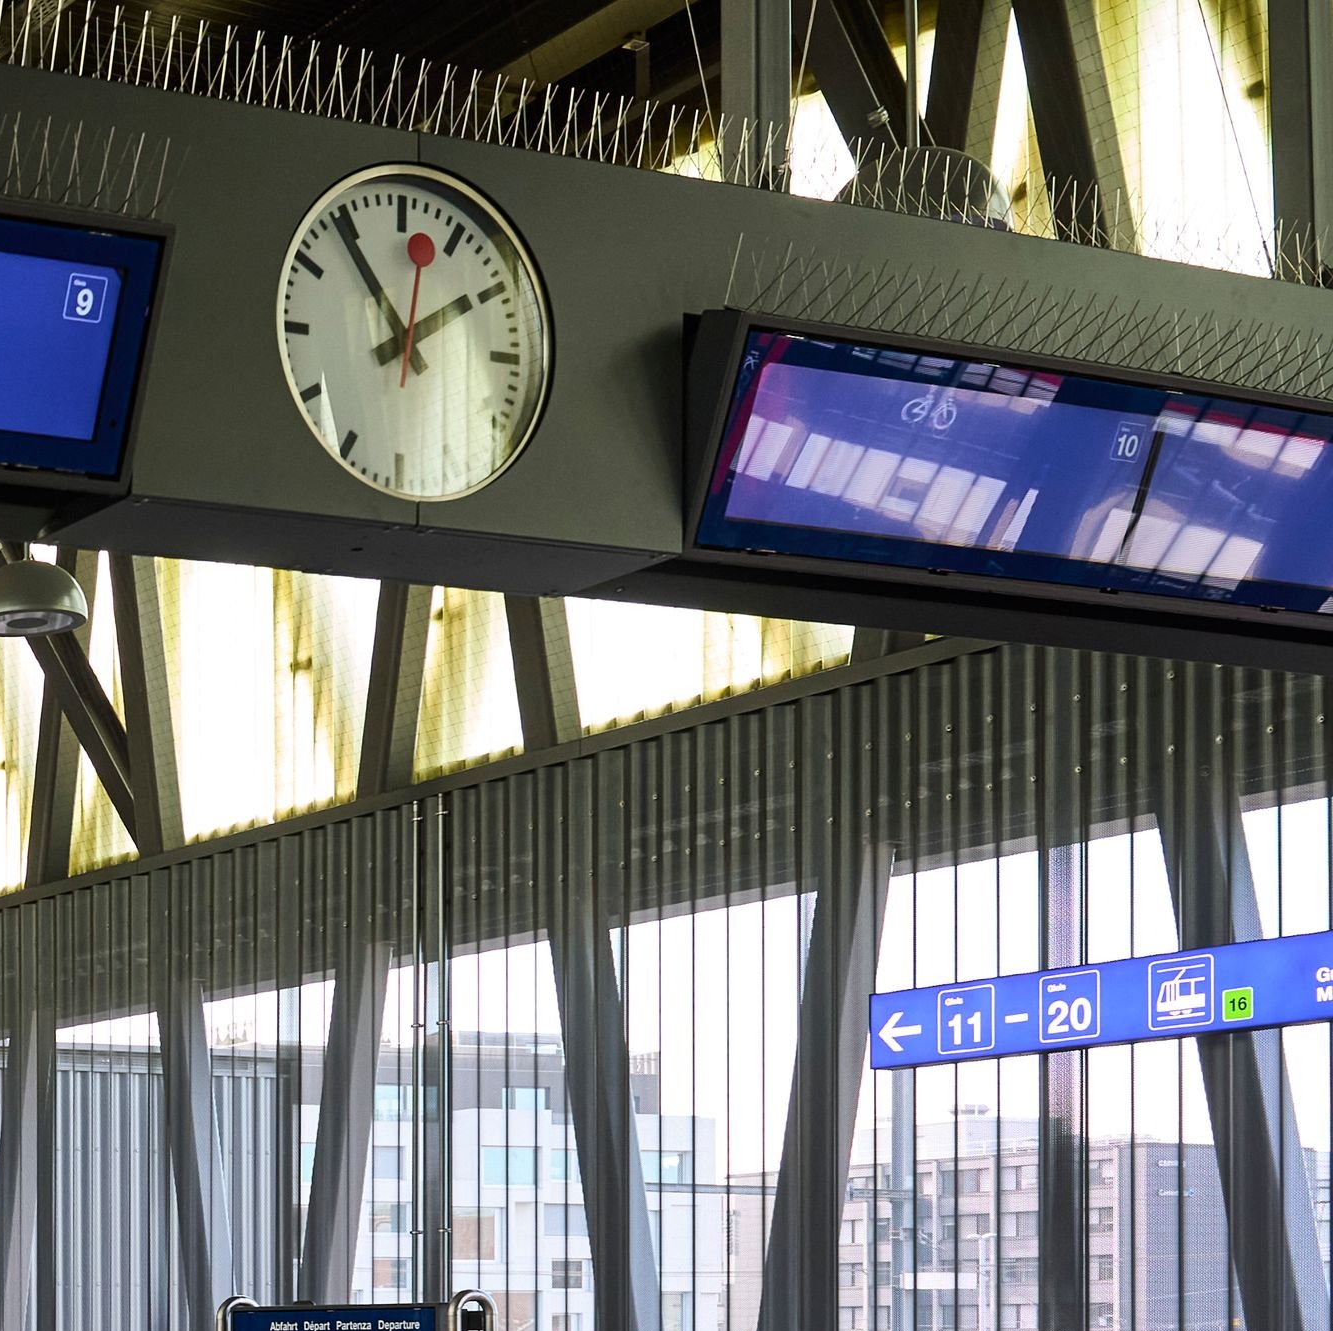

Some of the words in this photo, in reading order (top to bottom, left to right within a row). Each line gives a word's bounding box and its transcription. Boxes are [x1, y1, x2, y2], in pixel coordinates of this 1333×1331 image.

[75, 288, 94, 316] 9
[1117, 434, 1139, 458] 10
[1229, 996, 1248, 1012] 16
[948, 1011, 981, 1045] 11
[1047, 997, 1092, 1034] 20
[269, 1320, 299, 1331] Abfahrt
[335, 1320, 372, 1331] Partenza
